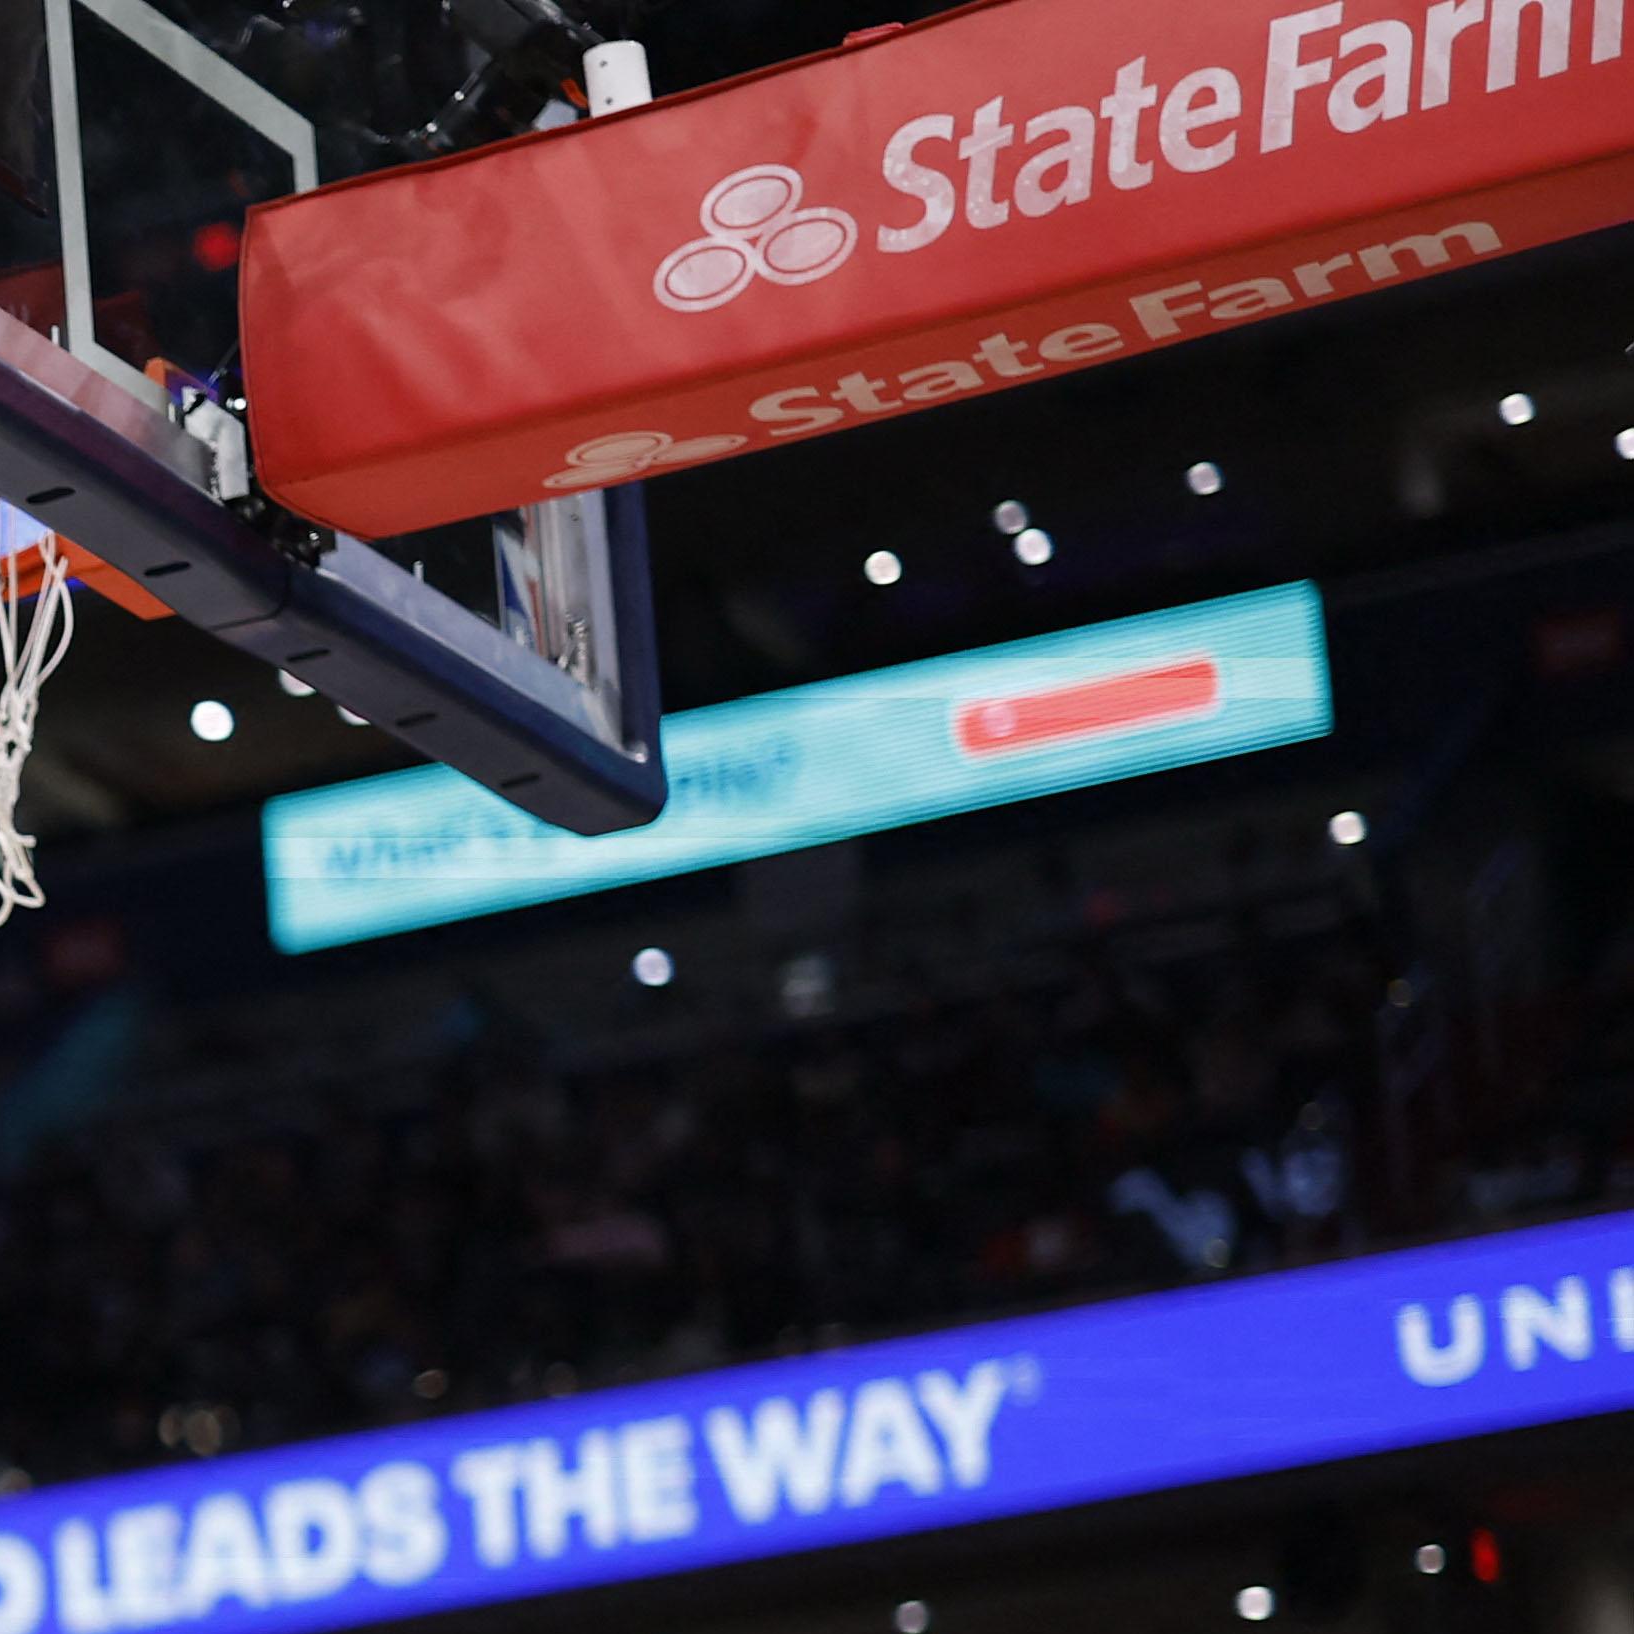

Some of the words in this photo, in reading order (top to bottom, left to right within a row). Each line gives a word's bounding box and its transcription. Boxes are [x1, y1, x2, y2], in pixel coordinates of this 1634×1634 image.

[877, 54, 1242, 253] State
[749, 322, 1125, 437] State
[1129, 219, 1503, 341] Farm
[451, 1414, 700, 1567] THE
